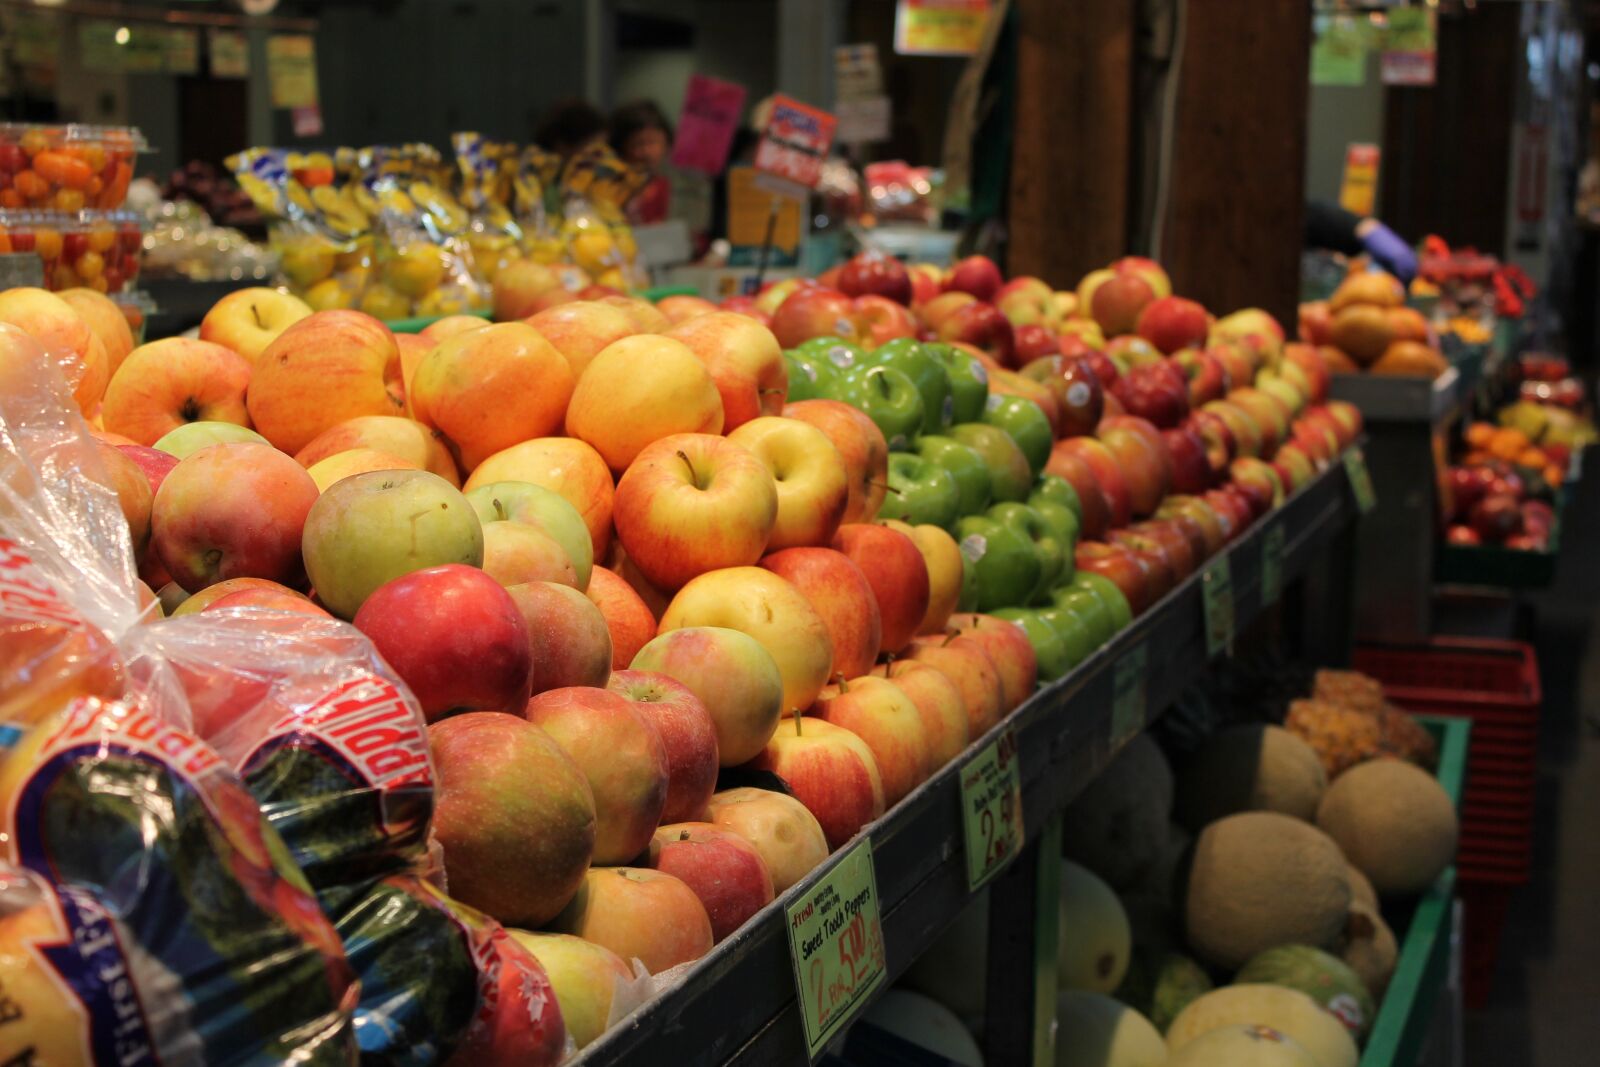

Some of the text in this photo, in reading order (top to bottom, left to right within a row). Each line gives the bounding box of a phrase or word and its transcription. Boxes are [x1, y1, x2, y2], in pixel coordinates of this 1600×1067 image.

[801, 927, 823, 961] Sweet
[823, 906, 845, 940] Tooth
[845, 886, 871, 918] Peppers
[809, 958, 831, 1025] 2
